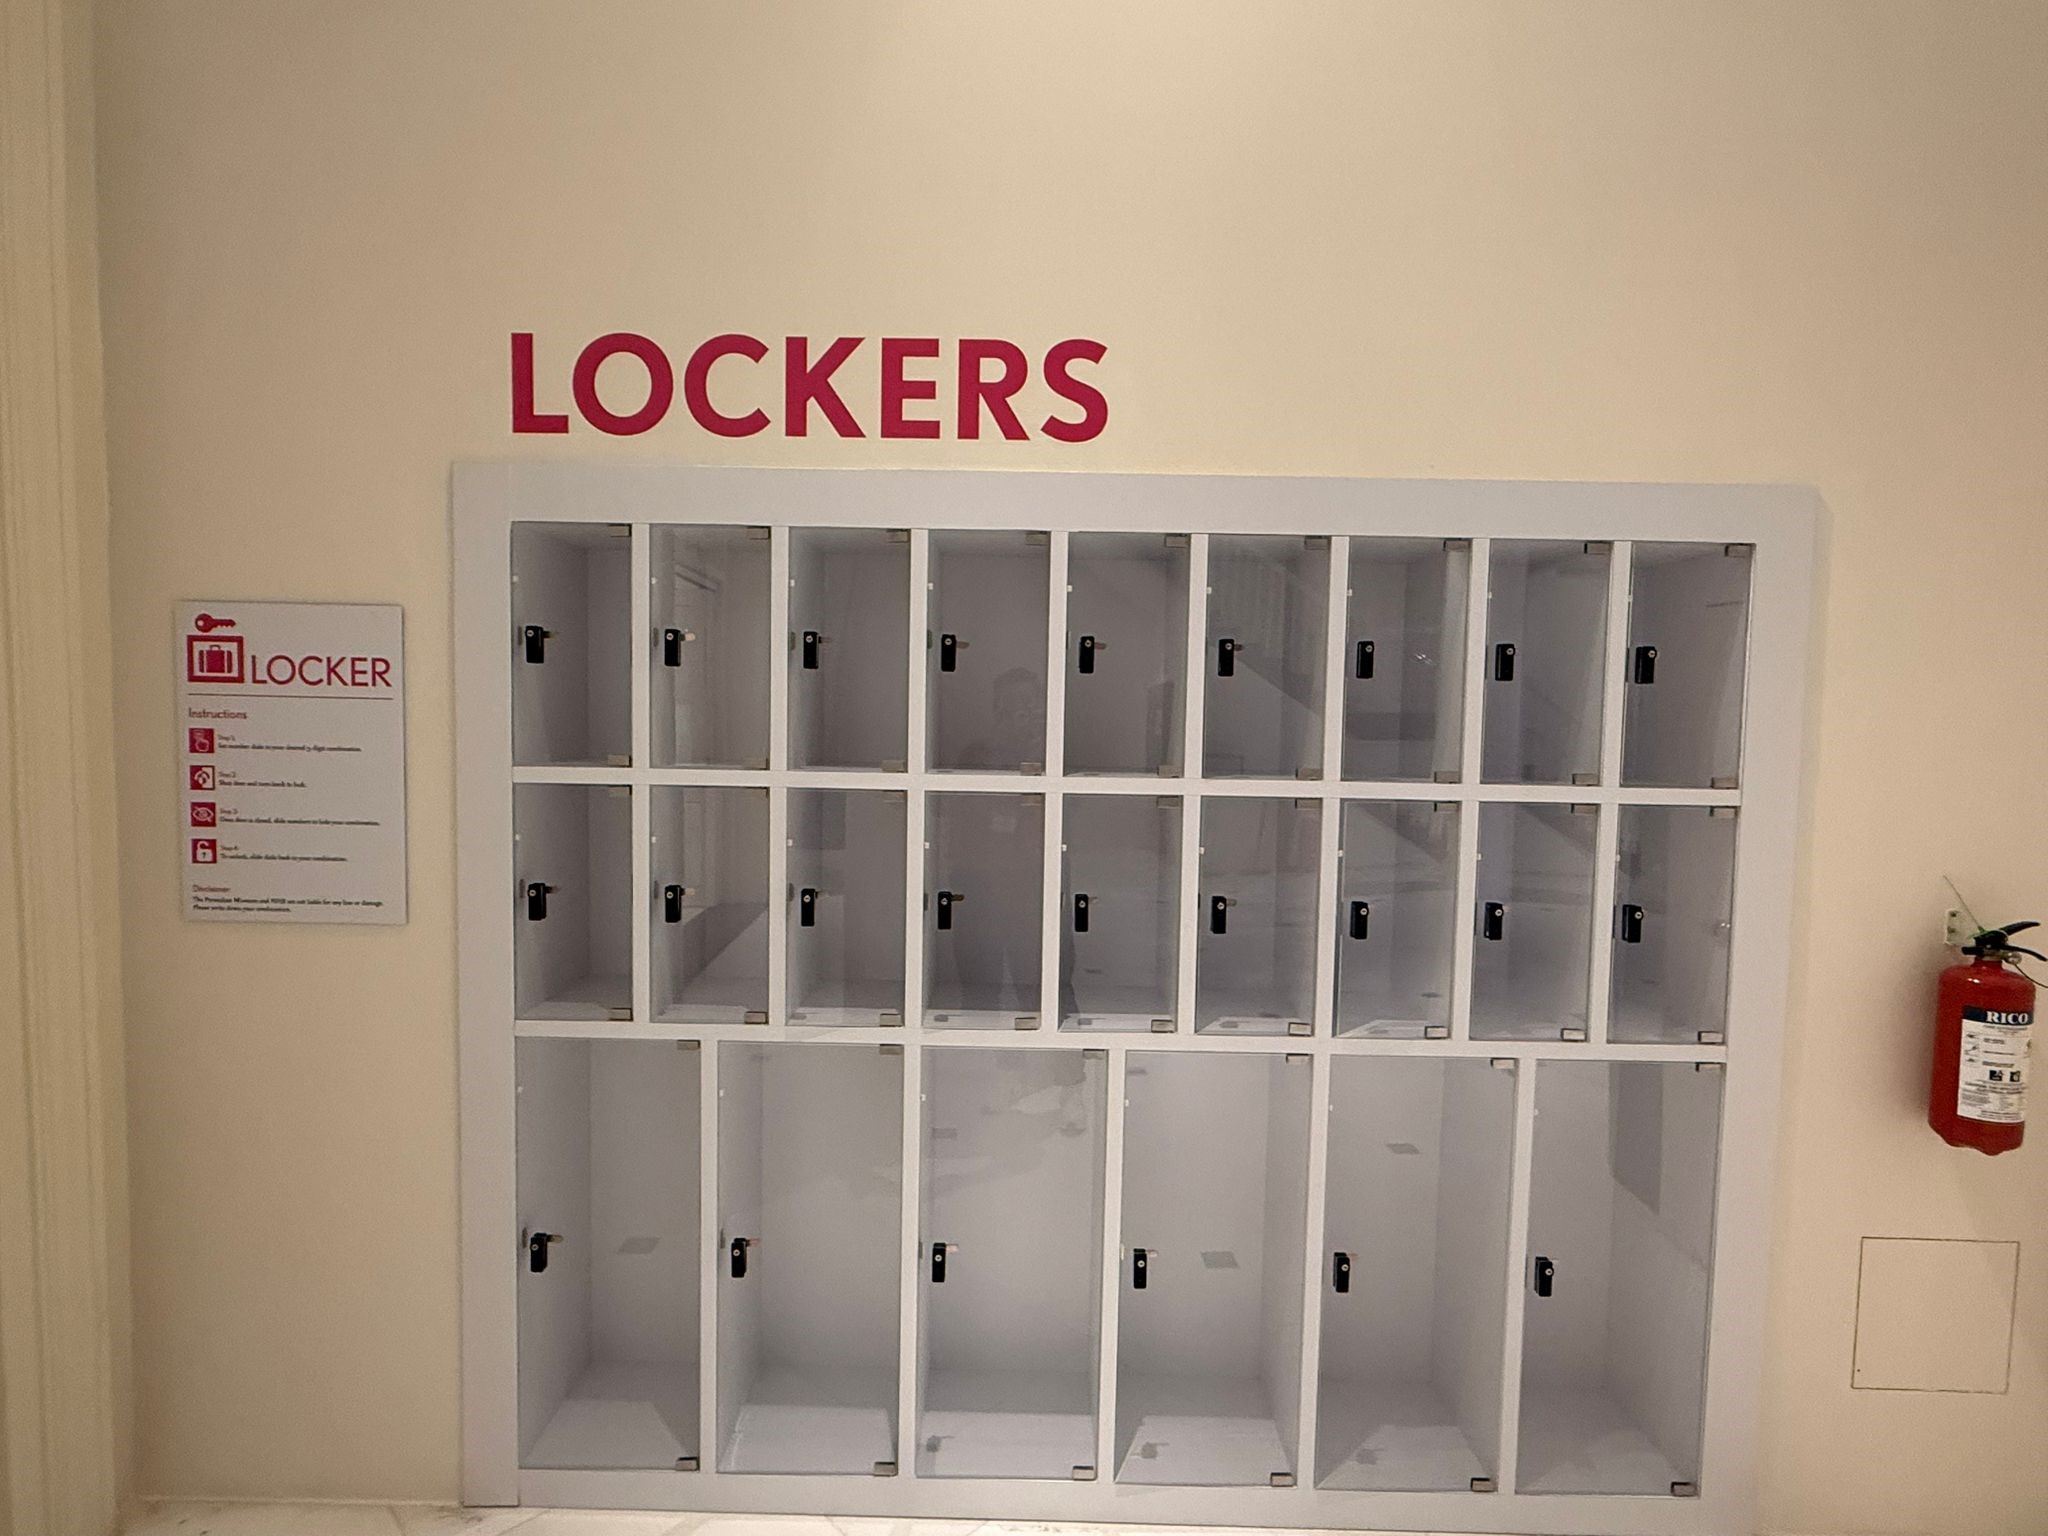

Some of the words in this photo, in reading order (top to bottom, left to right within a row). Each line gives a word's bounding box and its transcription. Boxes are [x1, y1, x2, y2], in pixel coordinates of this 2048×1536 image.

[511, 332, 1108, 442] LOCKERS
[251, 654, 392, 687] LOCKER
[188, 707, 247, 719] Instructions
[1986, 1010, 2028, 1024] RICO
